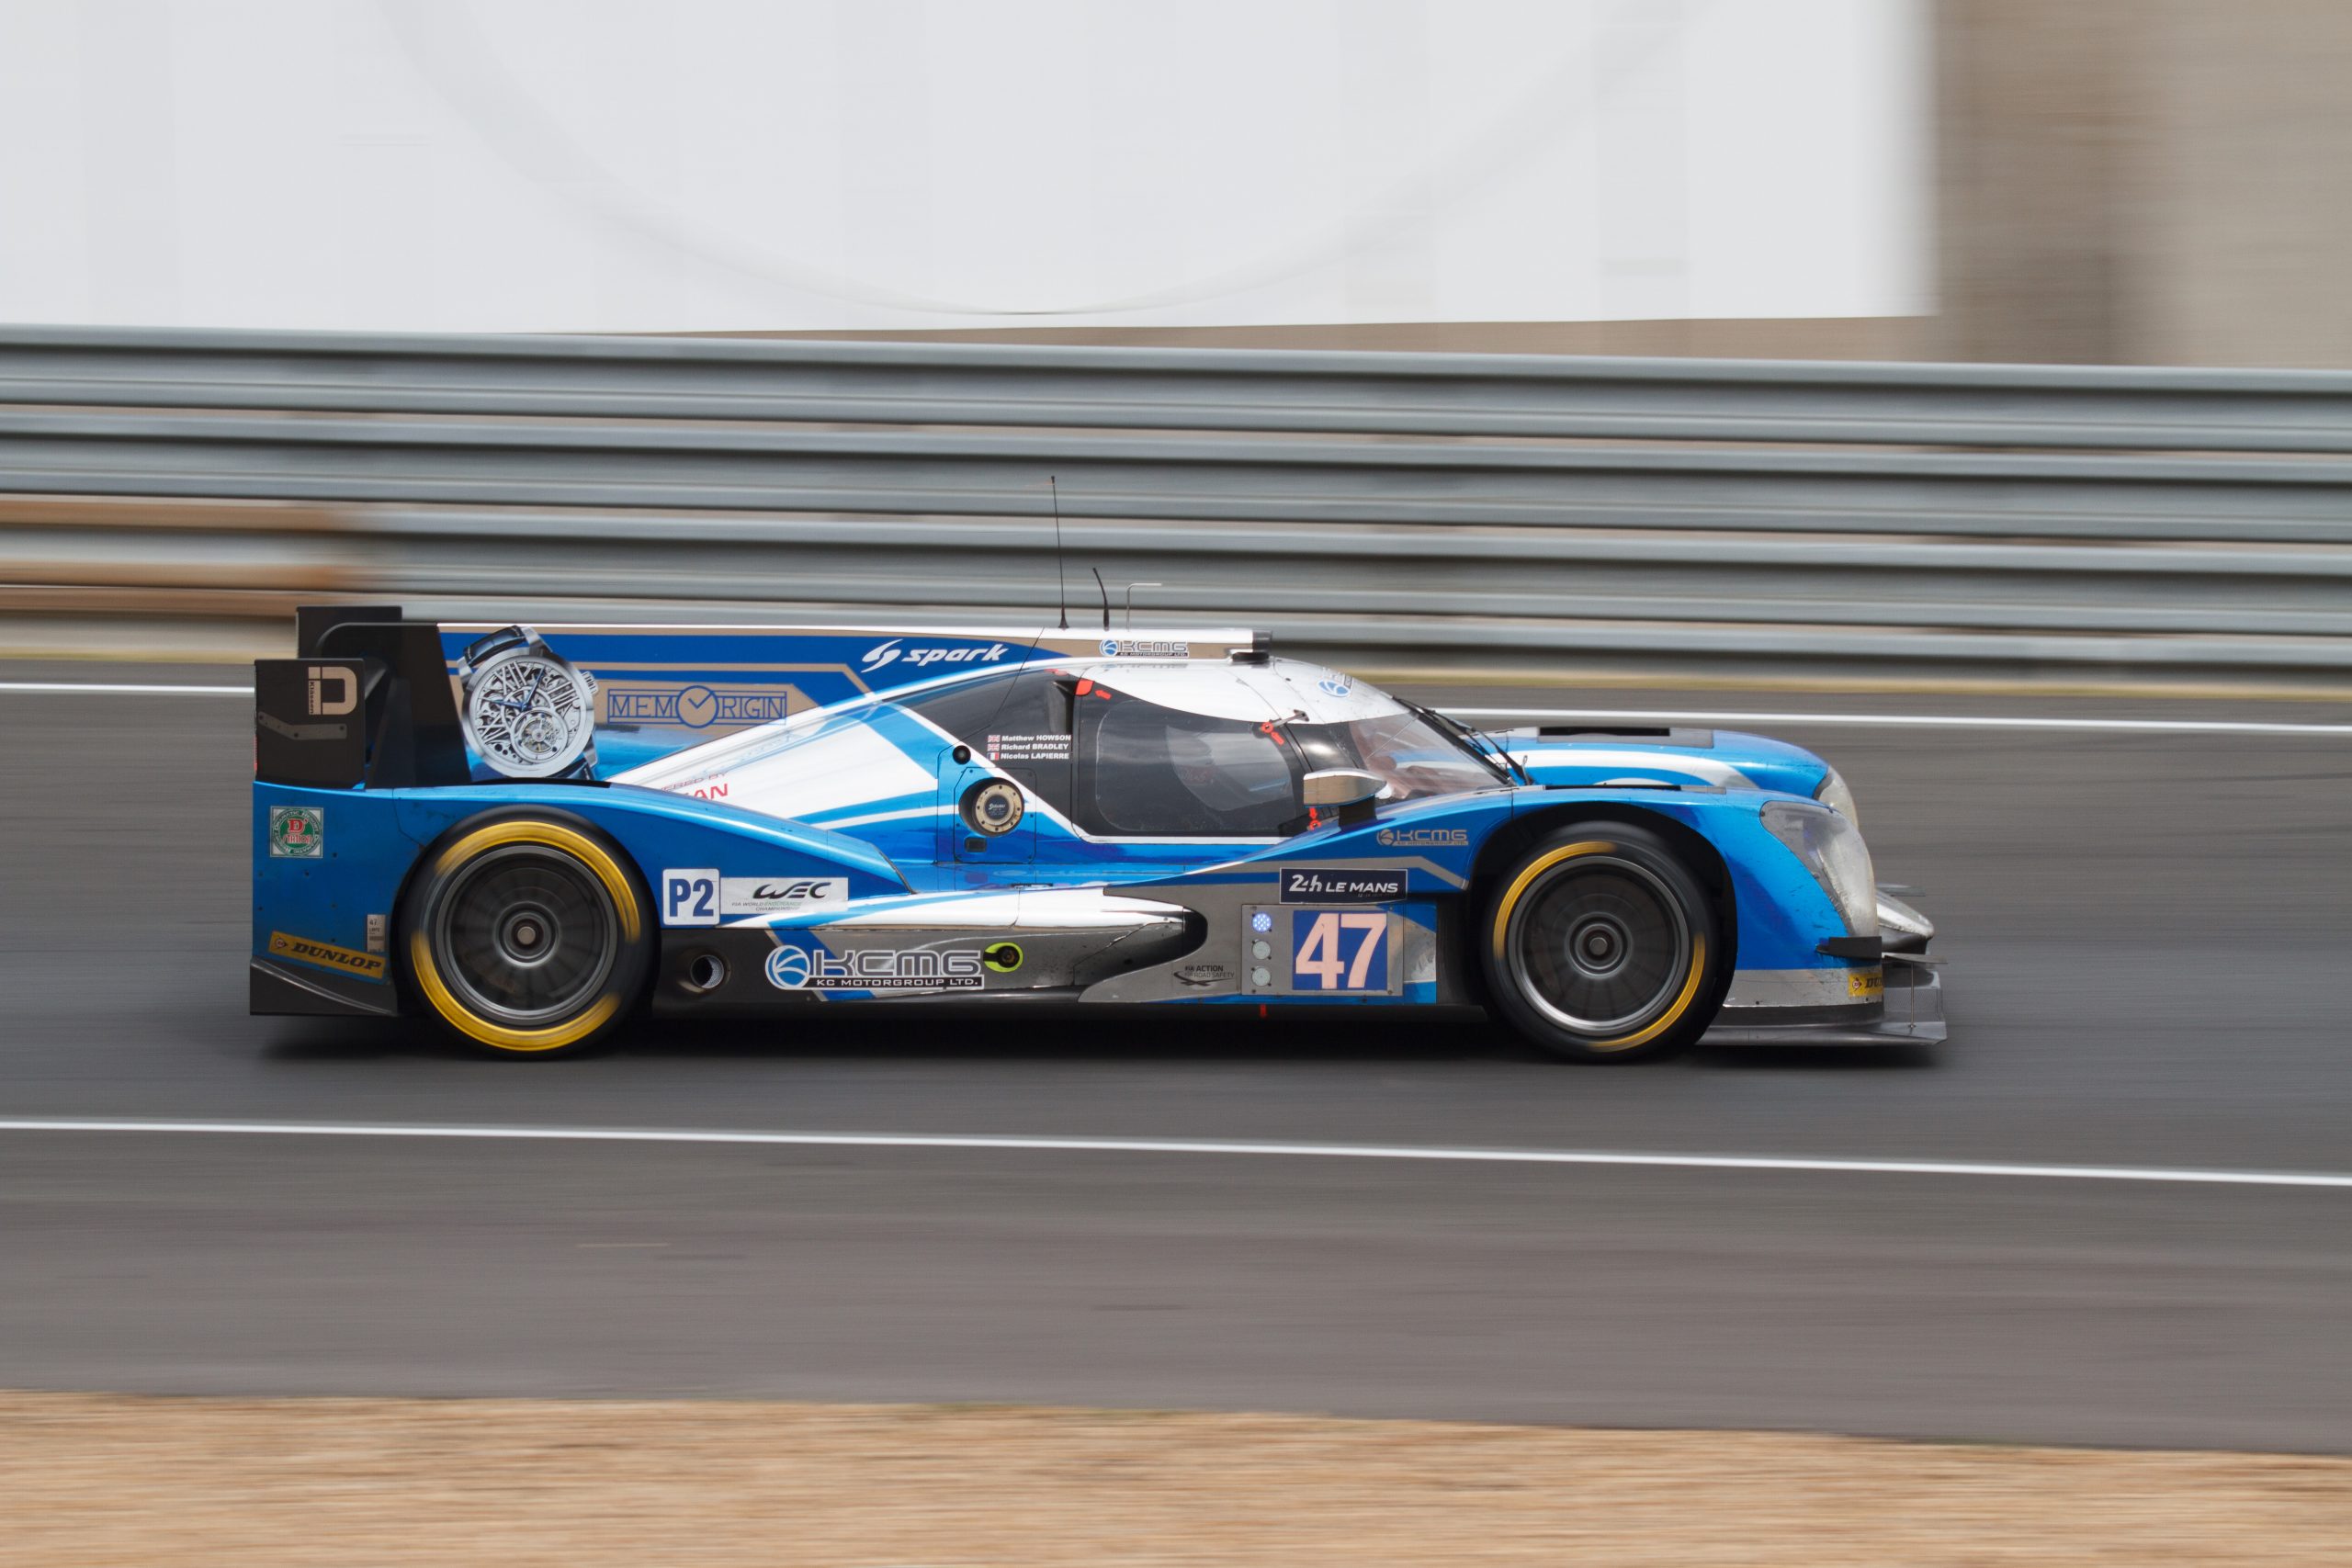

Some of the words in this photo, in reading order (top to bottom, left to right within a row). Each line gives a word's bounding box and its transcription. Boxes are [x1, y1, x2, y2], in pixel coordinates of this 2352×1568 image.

[901, 644, 1009, 666] spark
[669, 879, 714, 917] P2
[752, 882, 831, 899] WEC
[1326, 882, 1346, 892] LE
[1349, 882, 1398, 893] MANS
[291, 942, 382, 970] DUNLOP
[814, 950, 981, 976] KCMG
[1295, 913, 1387, 989] 47
[841, 978, 944, 987] MOTORGROUP
